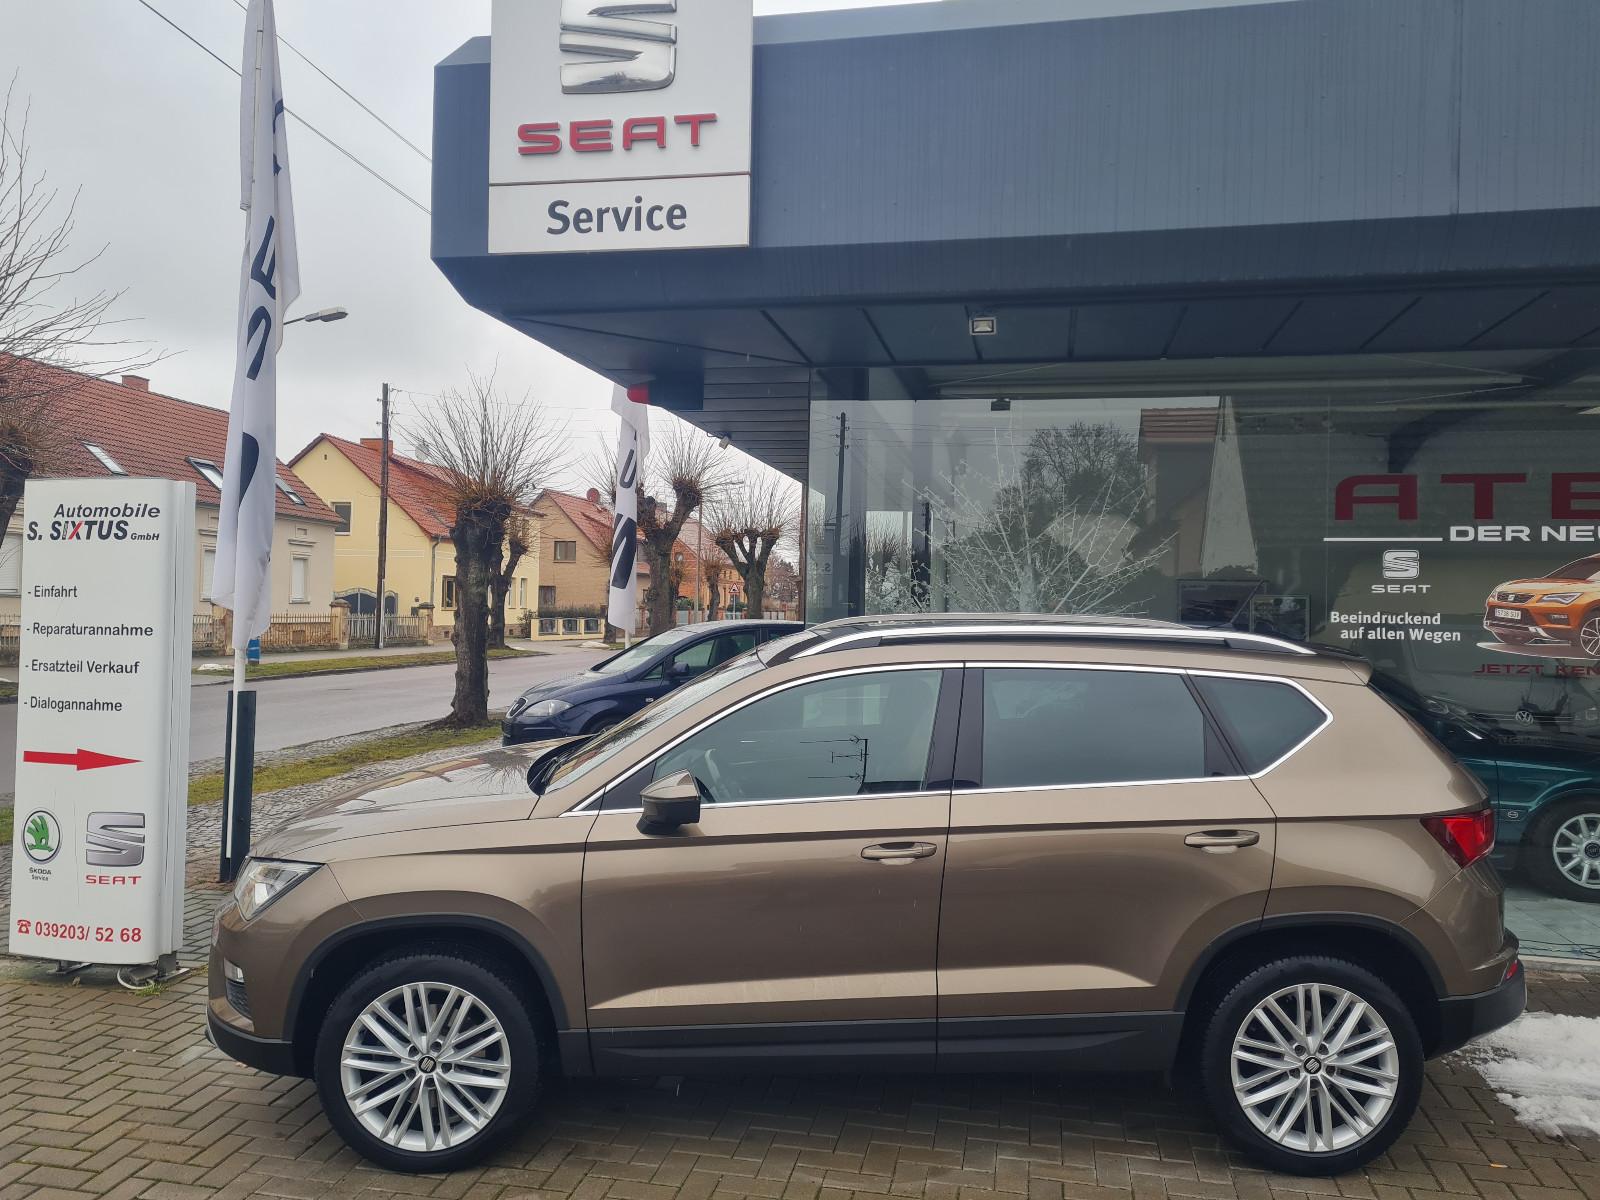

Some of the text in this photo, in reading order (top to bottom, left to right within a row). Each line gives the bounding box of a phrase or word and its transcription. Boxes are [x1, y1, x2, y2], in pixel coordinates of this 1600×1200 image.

[517, 112, 718, 156] SEAT
[546, 195, 688, 235] Service
[53, 502, 161, 519] Automobile
[26, 519, 160, 541] S. SIXTUS GmbH
[1450, 525, 1600, 542] DER NE
[33, 585, 78, 599] Einfahrt
[1371, 584, 1431, 594] SEAT
[1330, 611, 1441, 625] Beeindruckend
[32, 622, 154, 638] Reparaturannahme
[1340, 627, 1461, 644] auf allen Wegen
[31, 659, 83, 673] Ersatzteil
[87, 661, 140, 674] Verkauf
[1473, 664, 1544, 674] JETZT
[30, 696, 123, 712] Dialogannahme
[85, 875, 142, 885] SEAT
[34, 921, 142, 942] 039203/ 52 68
